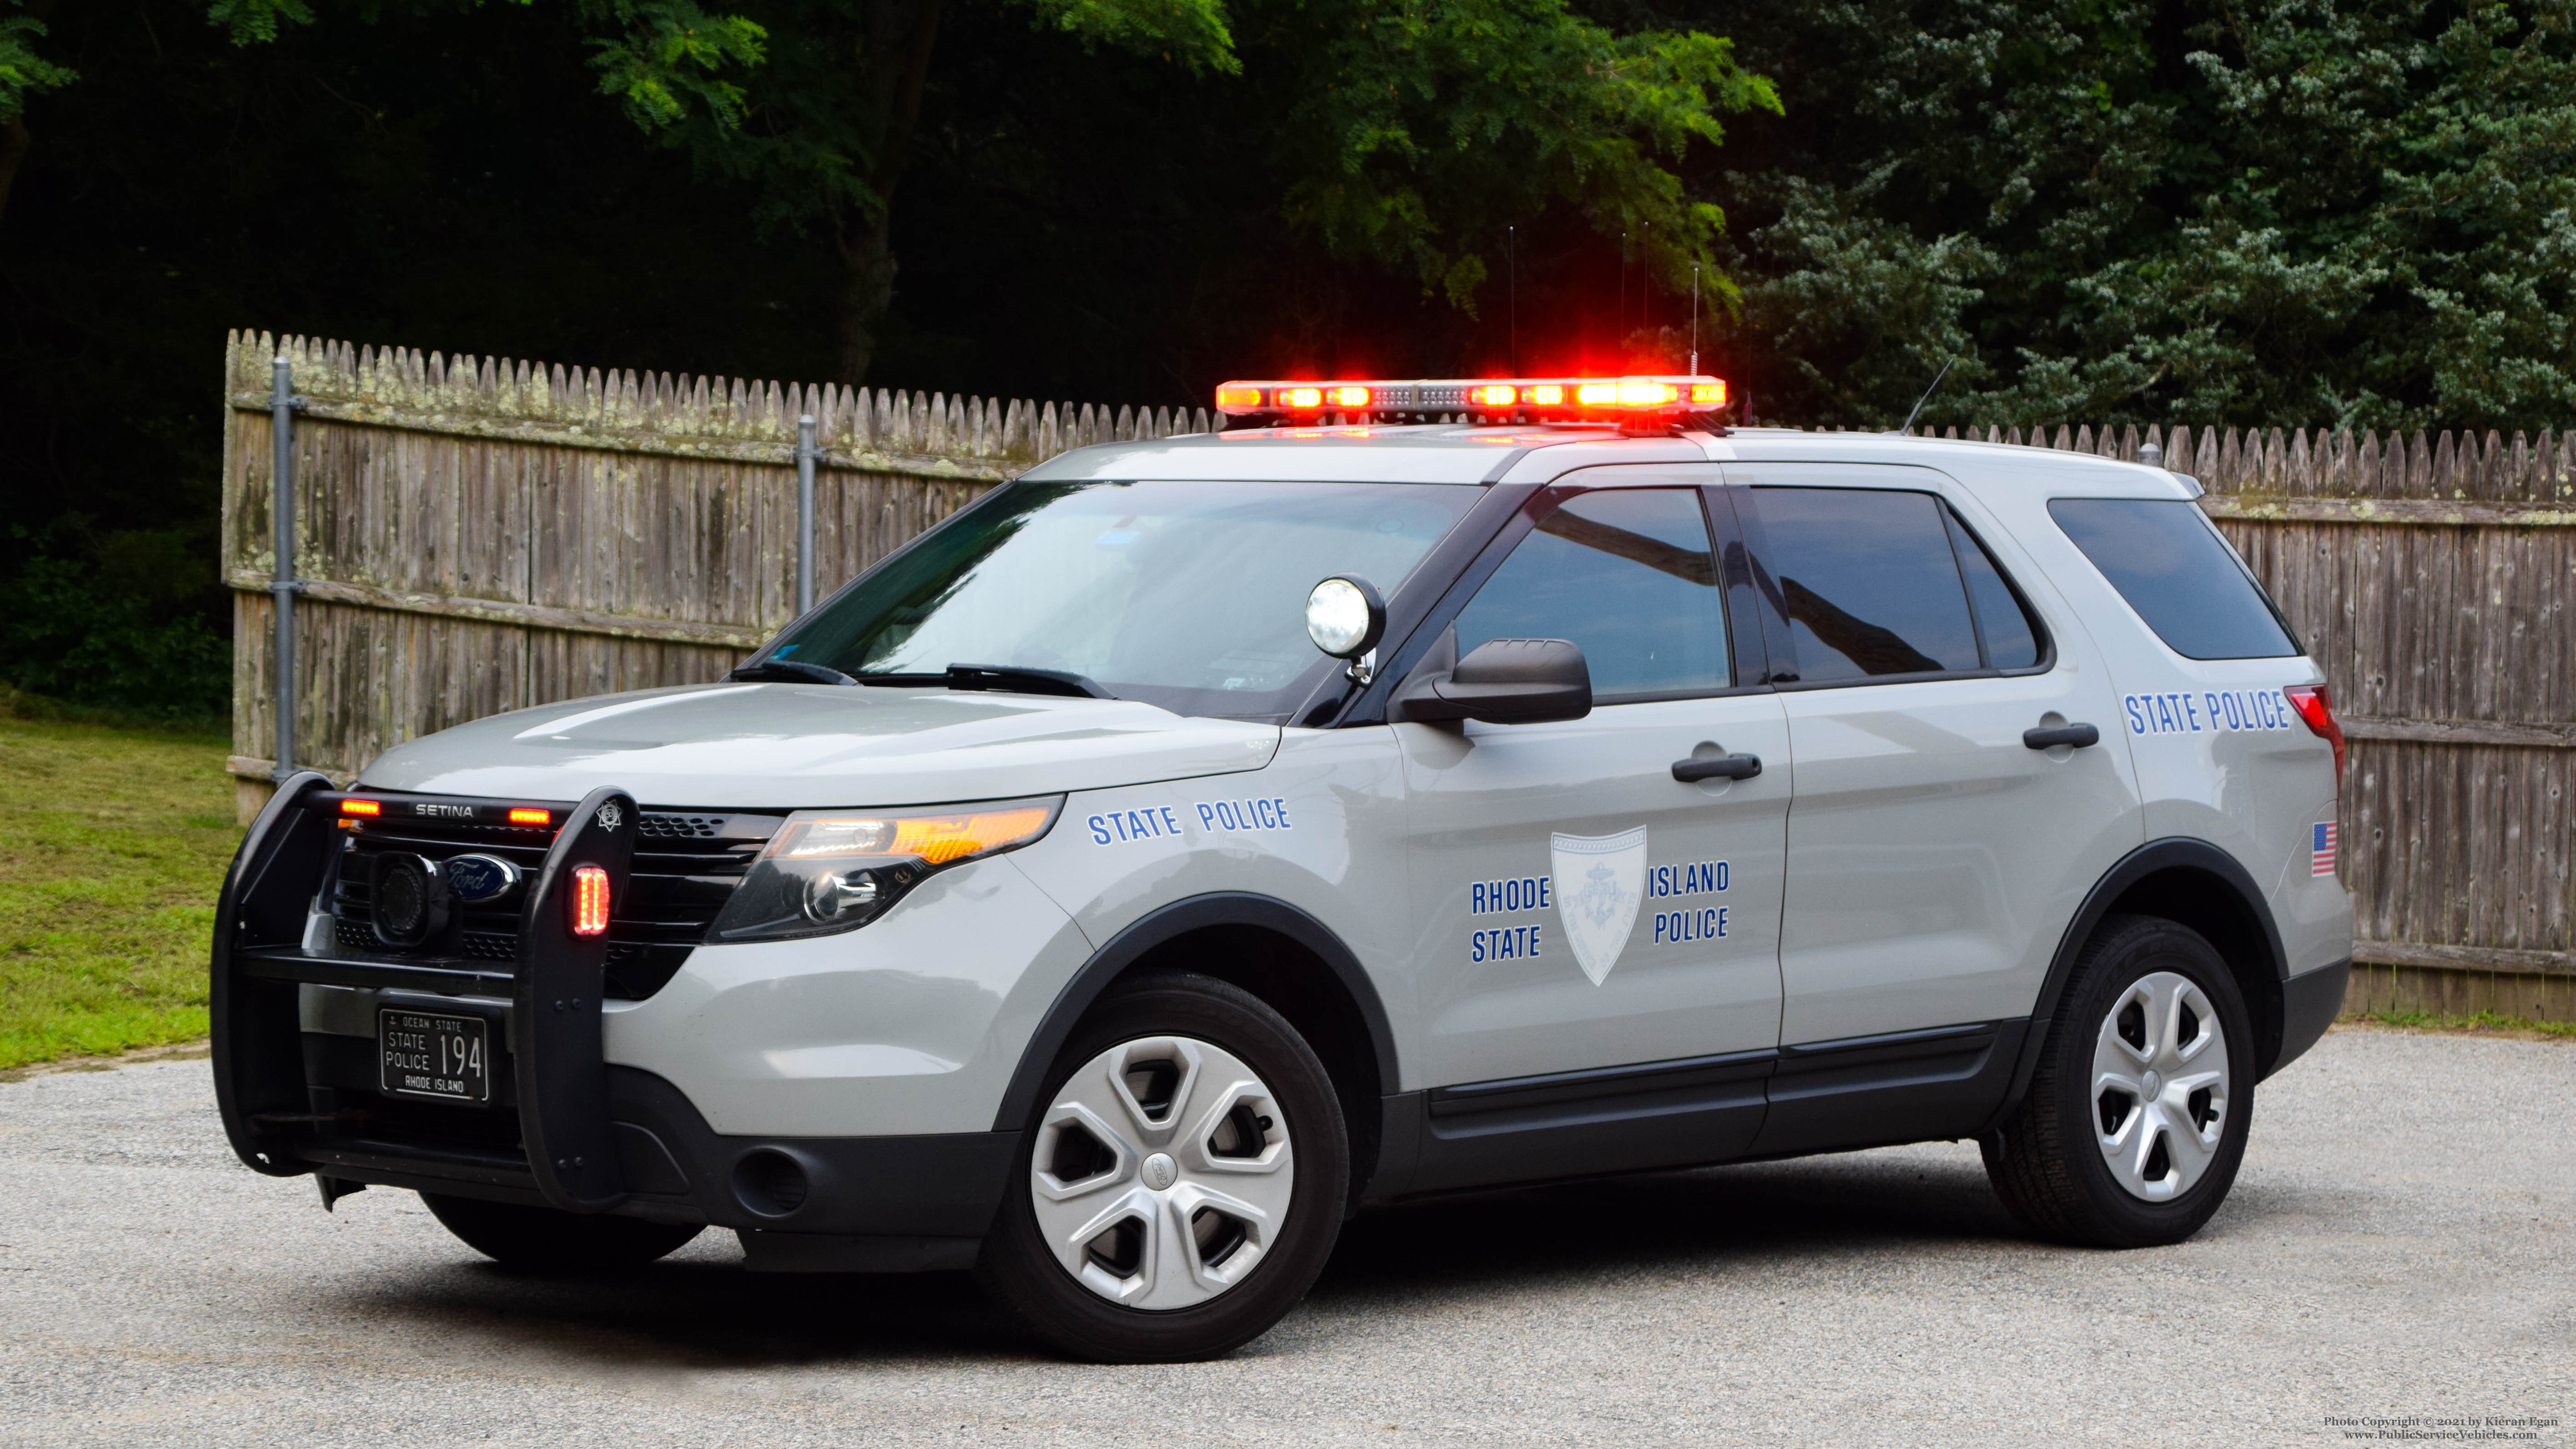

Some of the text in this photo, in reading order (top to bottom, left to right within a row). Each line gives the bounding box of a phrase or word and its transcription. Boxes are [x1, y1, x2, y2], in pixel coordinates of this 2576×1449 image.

[2125, 690, 2289, 735] STATE POLICE
[416, 804, 473, 817] SETINA
[1087, 798, 1291, 846] STATE POLICE
[448, 861, 489, 889] Ford
[1472, 861, 1729, 914] RHODE ISLAND
[1472, 924, 1541, 963] STATE
[1654, 907, 1729, 945] POLICE
[403, 1017, 461, 1033] OCEAN STATE
[389, 1032, 426, 1050] STATE
[386, 1051, 430, 1070] POLICE
[440, 1034, 481, 1078] 194
[405, 1074, 464, 1093] RHODE ISLAND
